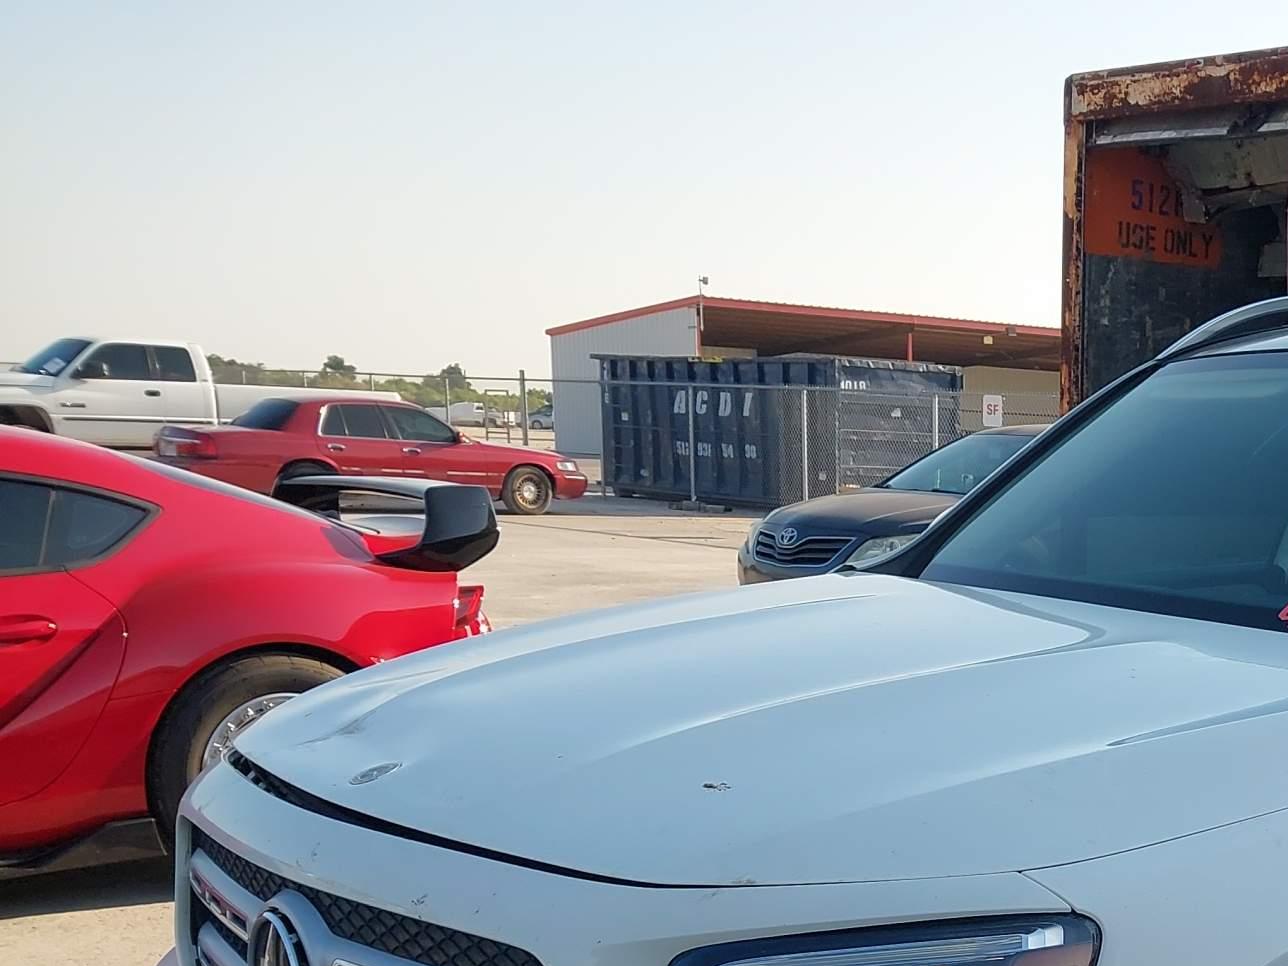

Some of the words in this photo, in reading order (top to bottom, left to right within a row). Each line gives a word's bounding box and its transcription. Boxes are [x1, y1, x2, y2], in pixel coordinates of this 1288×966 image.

[1118, 221, 1157, 252] USE
[1163, 228, 1213, 259] ONLY
[986, 403, 999, 416] SF
